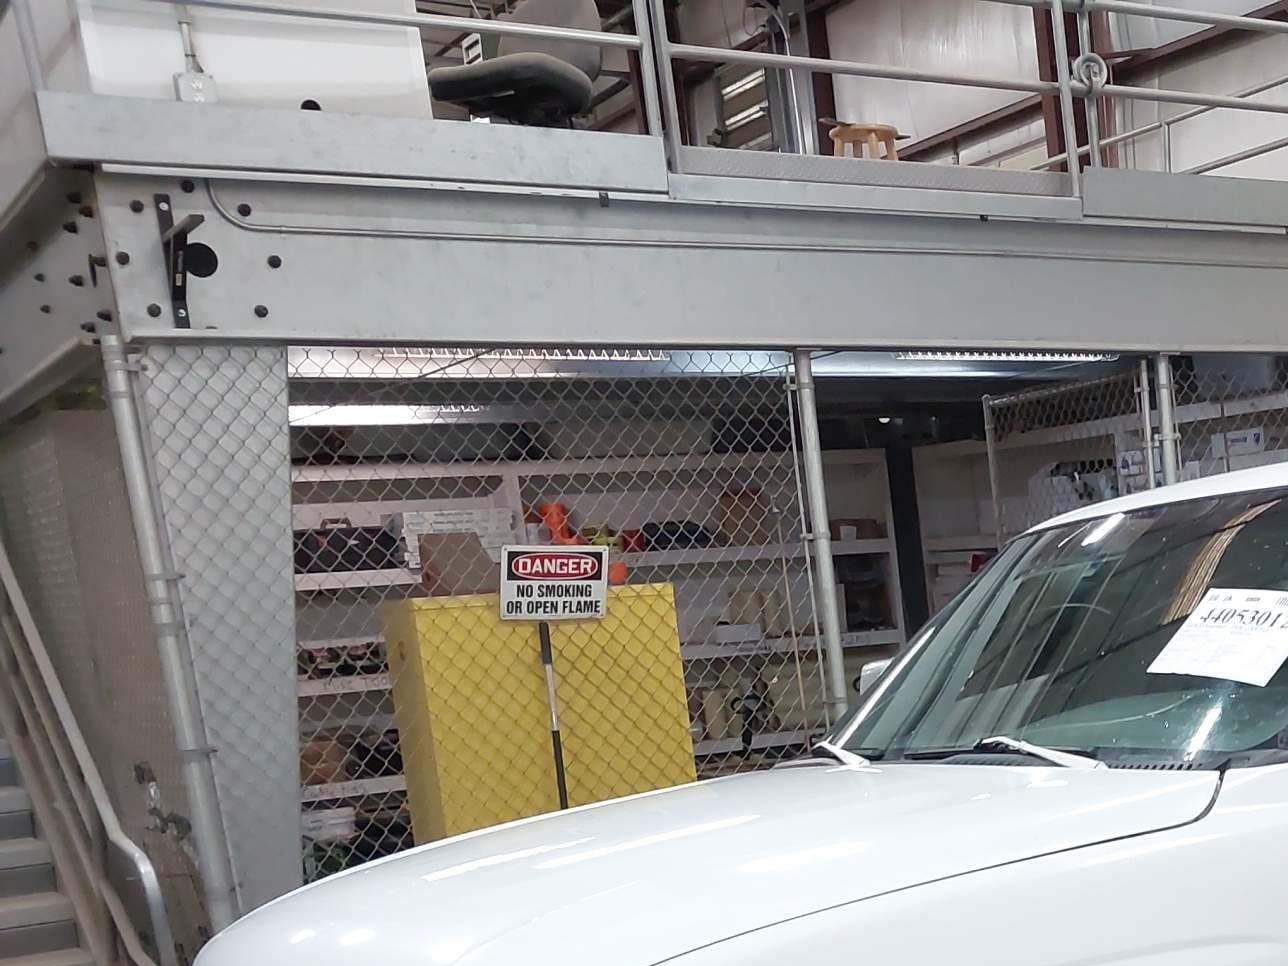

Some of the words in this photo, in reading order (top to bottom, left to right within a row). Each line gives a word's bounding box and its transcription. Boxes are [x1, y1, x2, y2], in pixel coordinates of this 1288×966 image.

[518, 558, 593, 574] DANGER
[516, 584, 534, 598] NO
[537, 584, 592, 598] SMOKING
[506, 600, 523, 614] OR
[526, 600, 559, 614] OPEN
[562, 600, 601, 614] FLAME
